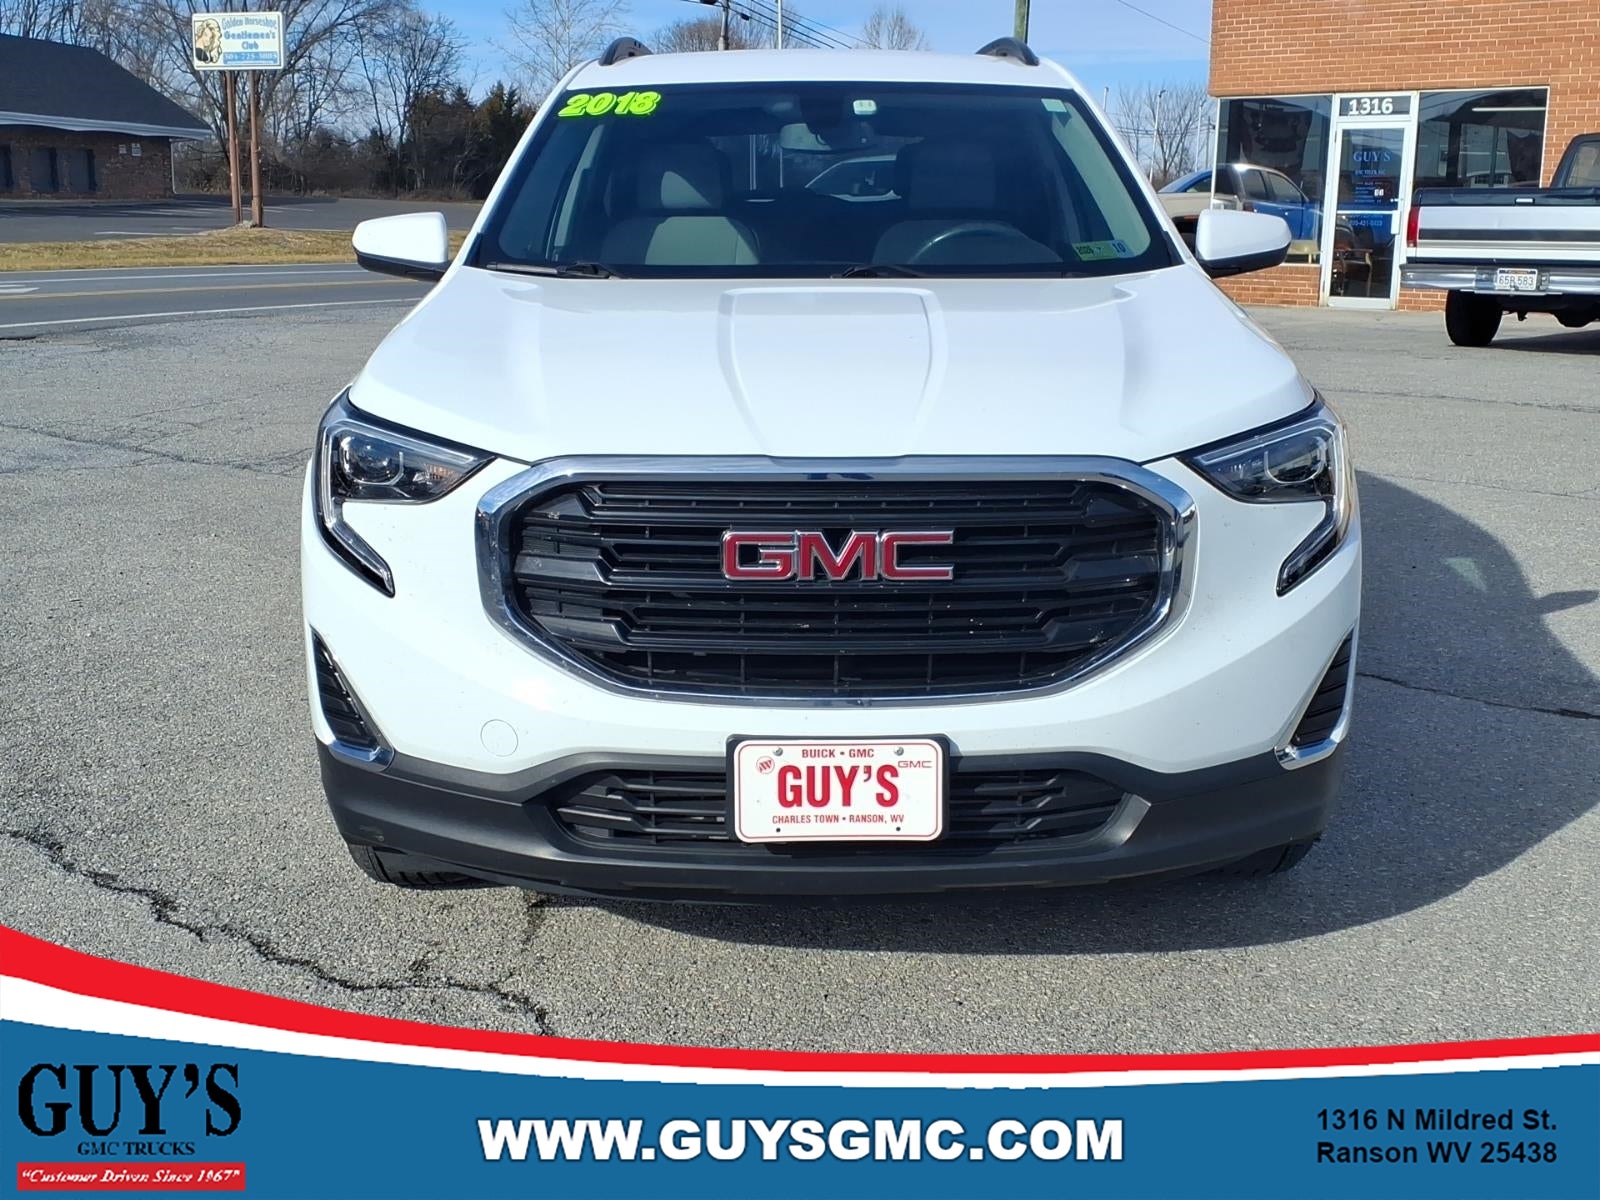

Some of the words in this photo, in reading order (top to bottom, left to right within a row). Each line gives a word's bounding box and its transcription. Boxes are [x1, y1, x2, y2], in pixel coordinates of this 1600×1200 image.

[224, 30, 276, 39] Gentlemen's
[241, 41, 259, 50] Club
[558, 91, 661, 116] 2018
[1349, 98, 1393, 115] 1316
[721, 530, 954, 581] GMC
[802, 748, 835, 758] BUICK
[848, 748, 875, 758] GMC
[897, 760, 932, 768] GMC
[777, 764, 899, 808] GUY'S
[772, 815, 811, 824] CHARLES
[814, 815, 839, 823] TOWN
[849, 814, 887, 824] RANSON,
[890, 814, 904, 823] WV
